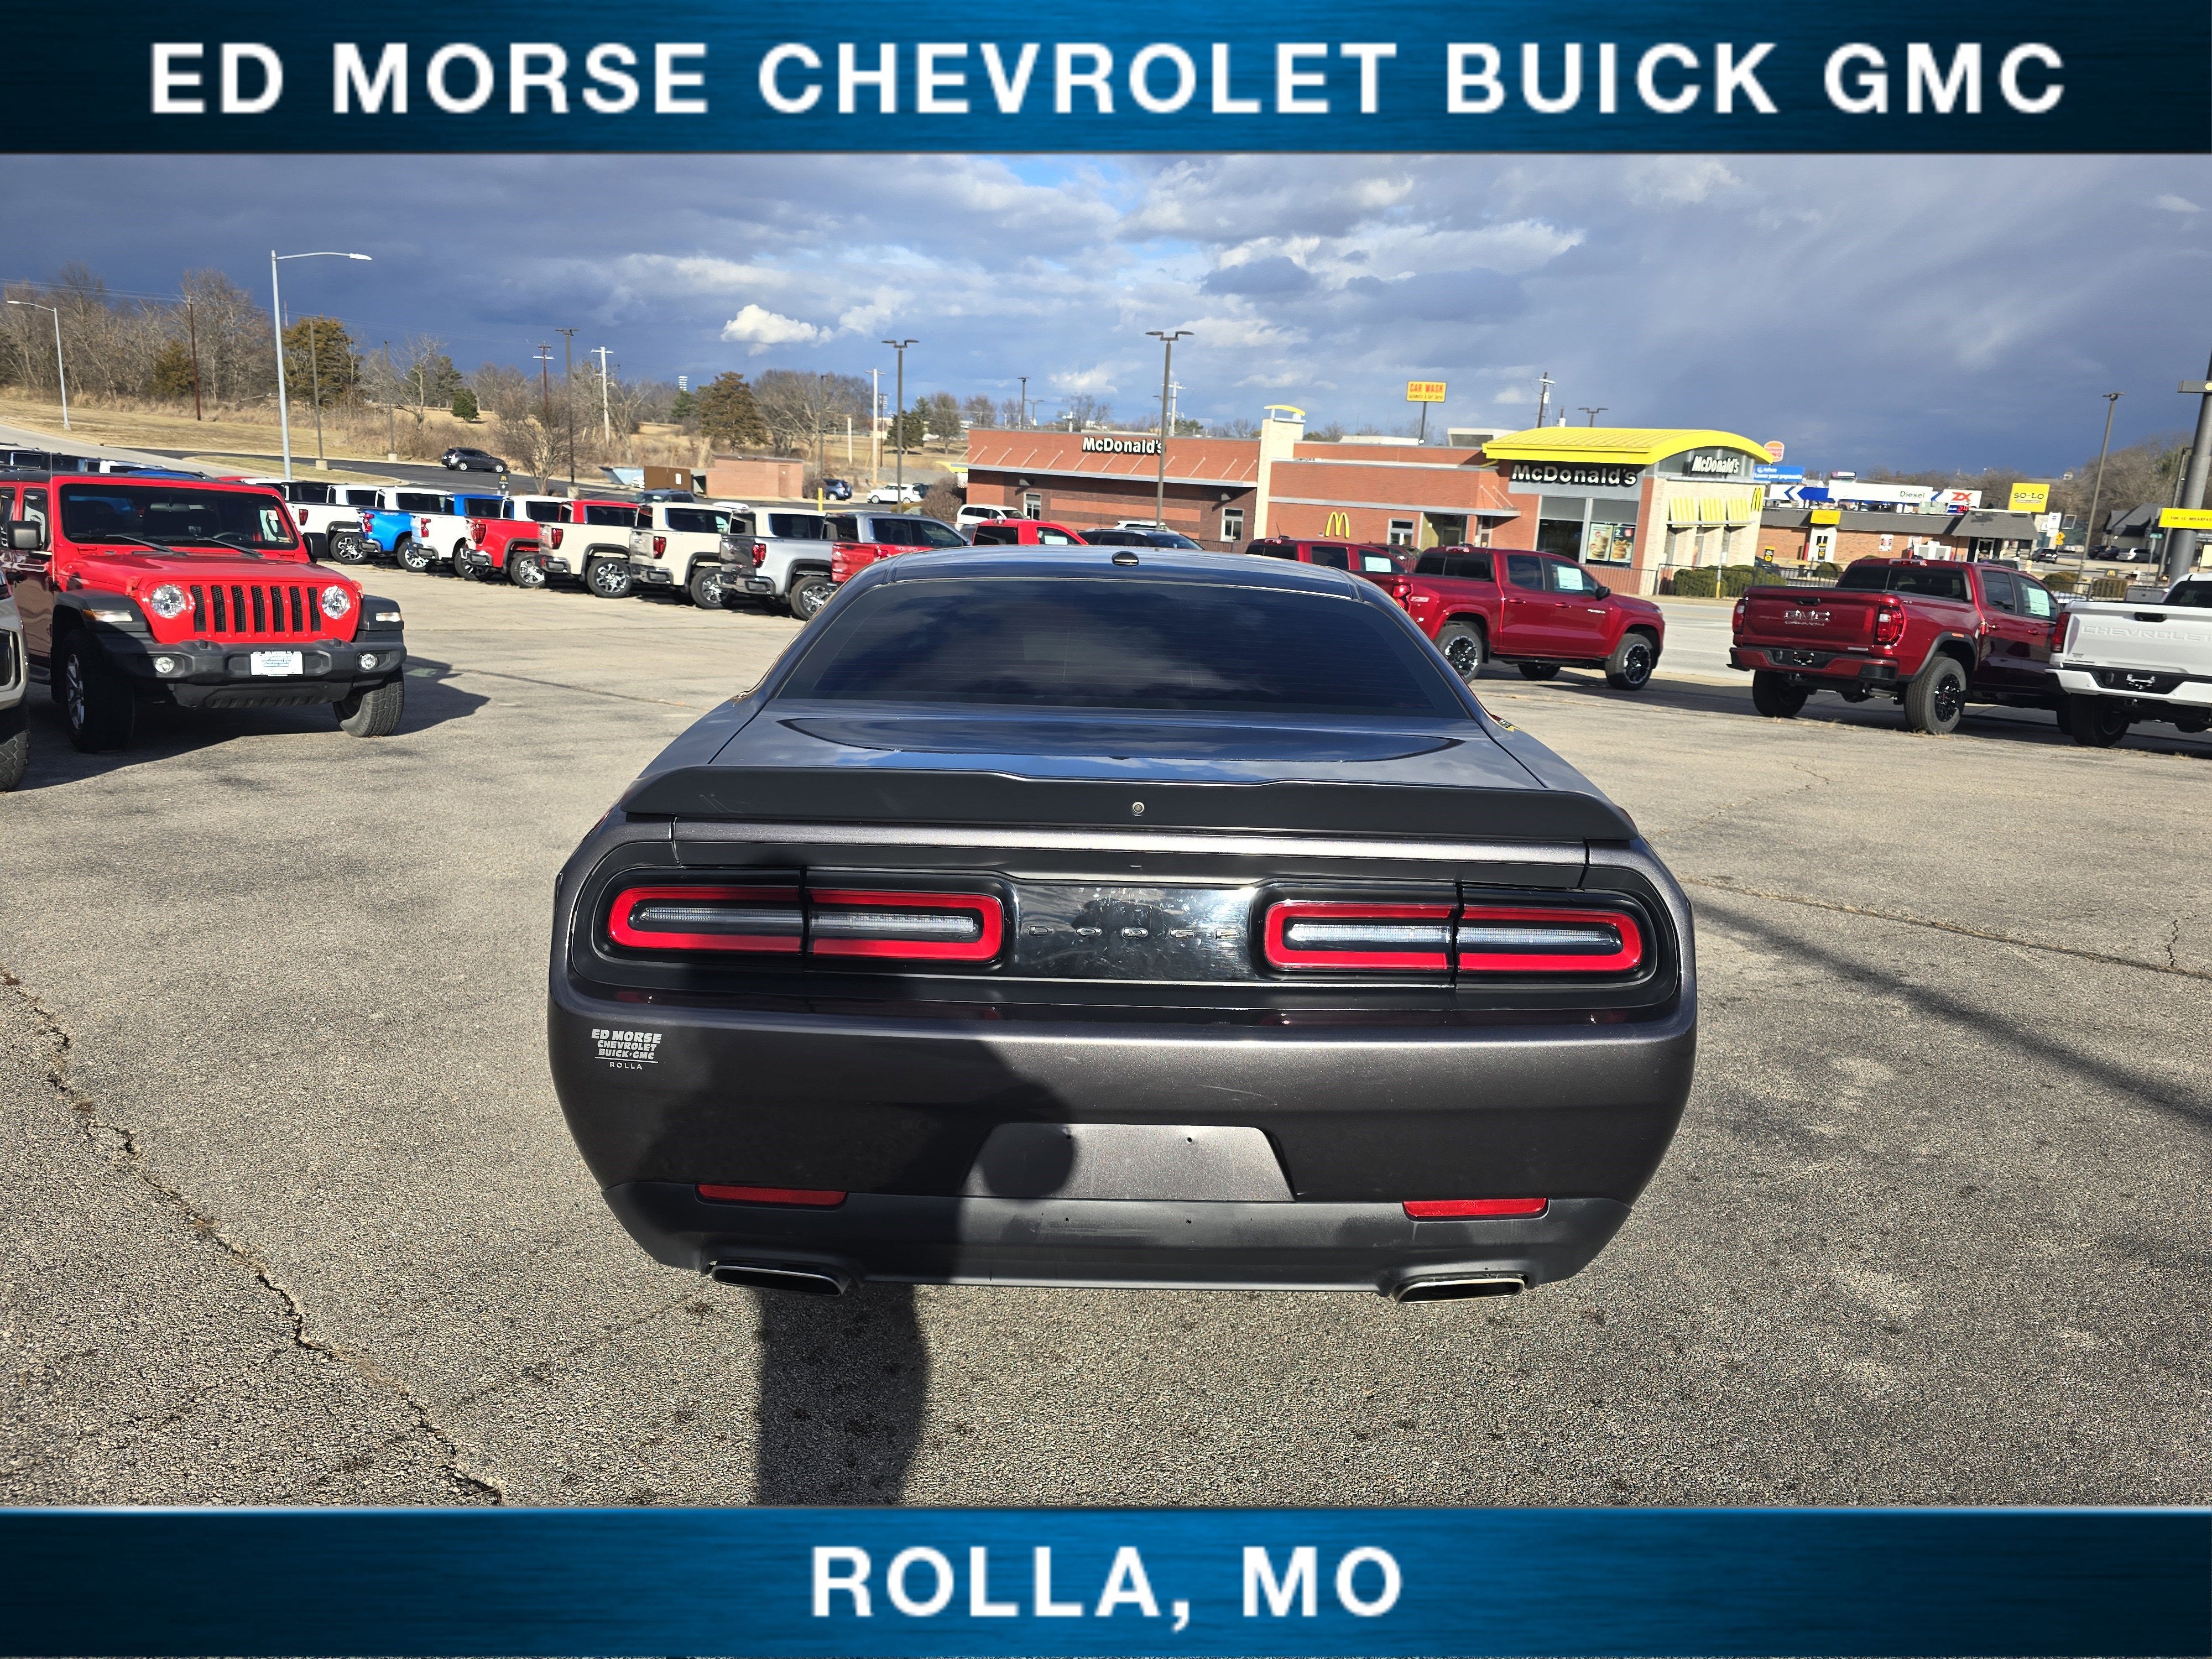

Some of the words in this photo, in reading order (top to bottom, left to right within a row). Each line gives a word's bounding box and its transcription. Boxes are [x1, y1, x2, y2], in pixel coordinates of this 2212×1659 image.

[1410, 383, 1422, 392] CAR
[1425, 384, 1443, 393] WASH
[1082, 436, 1162, 453] McDonald's
[1691, 455, 1740, 474] McDonald's
[1511, 464, 1637, 485] McDonald's
[2081, 625, 2212, 643] CHEVROLET
[1028, 925, 1239, 940] DODGE
[591, 1029, 610, 1040] ED
[612, 1030, 662, 1044] MORSE
[597, 1040, 658, 1052] CHEVROLET
[609, 1061, 643, 1070] ROLLA
